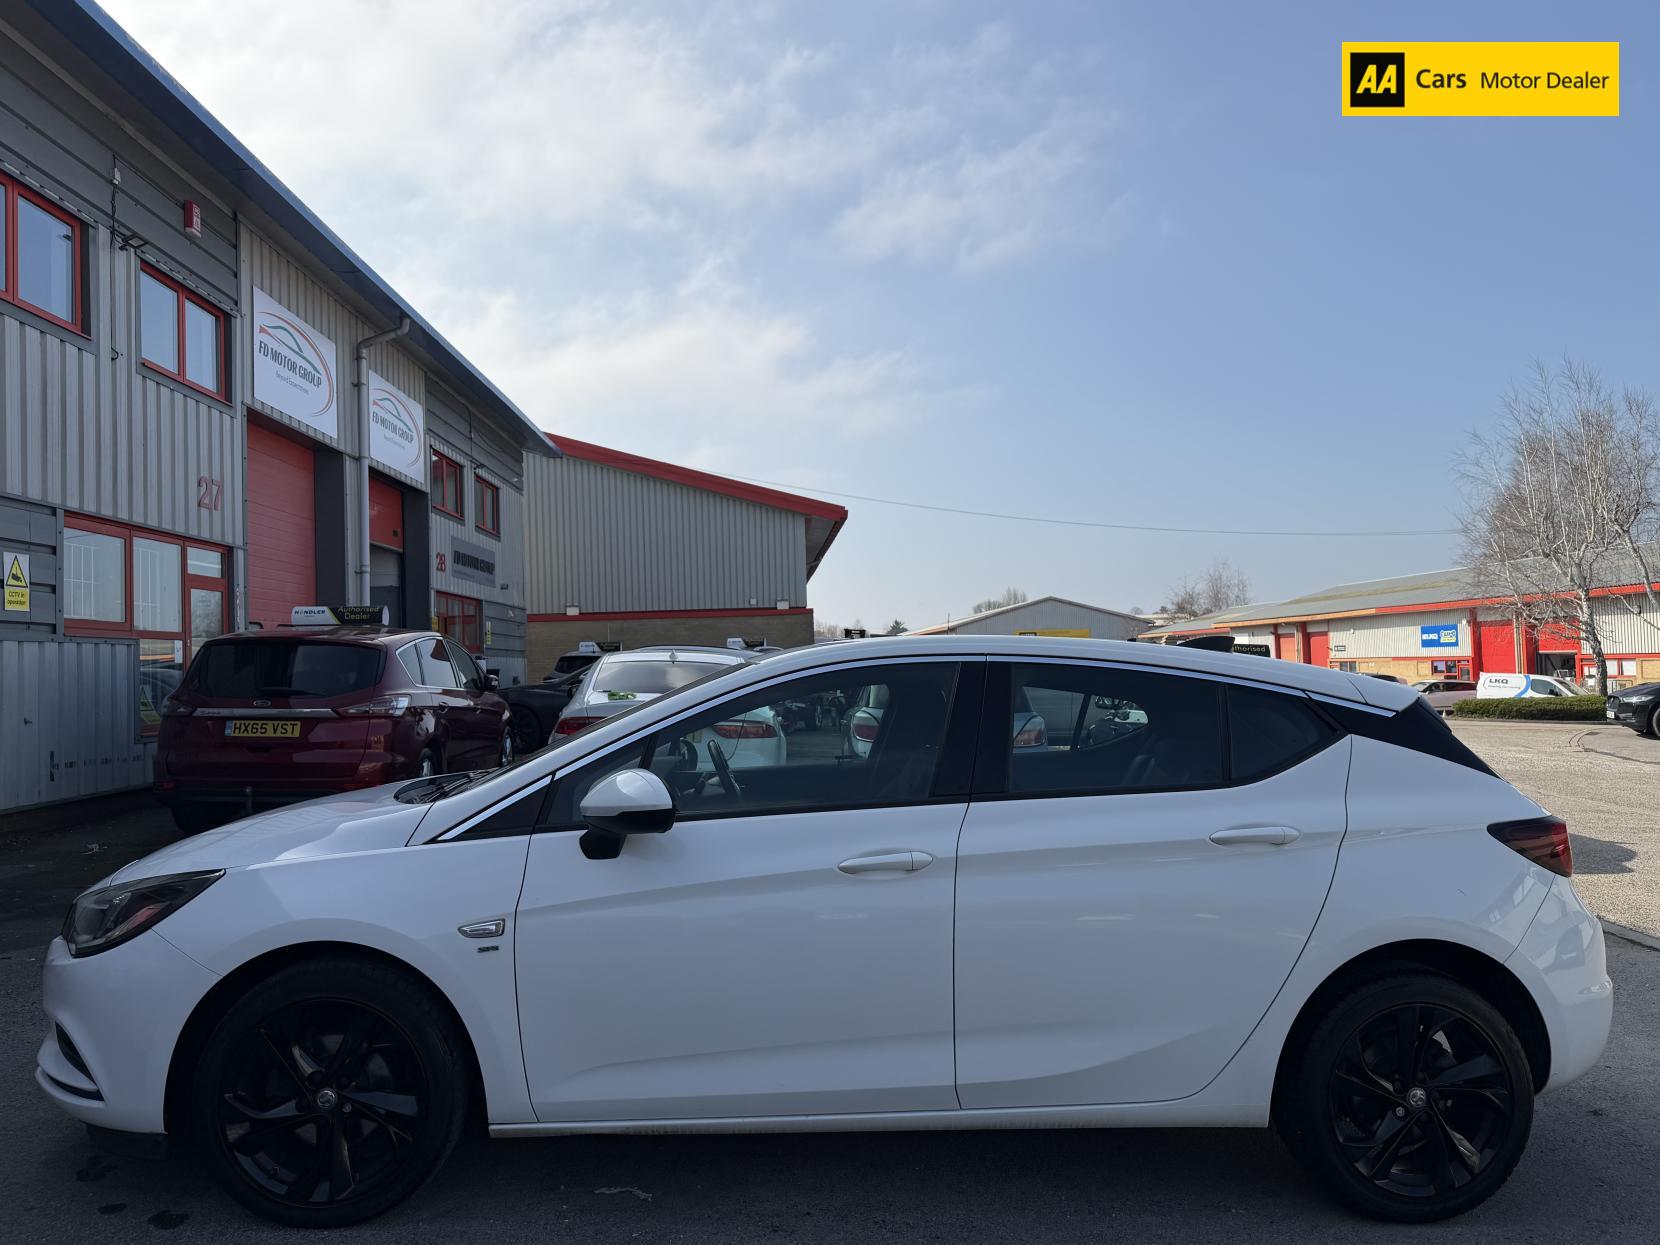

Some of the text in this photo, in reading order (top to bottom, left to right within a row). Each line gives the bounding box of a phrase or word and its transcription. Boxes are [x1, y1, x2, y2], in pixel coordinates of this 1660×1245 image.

[258, 340, 322, 388] FD MOTOR GROUP
[372, 411, 380, 424] FD
[380, 417, 397, 435] MOTOR
[198, 476, 222, 511] 27
[436, 552, 446, 572] 28
[232, 722, 298, 734] HX65 VST
